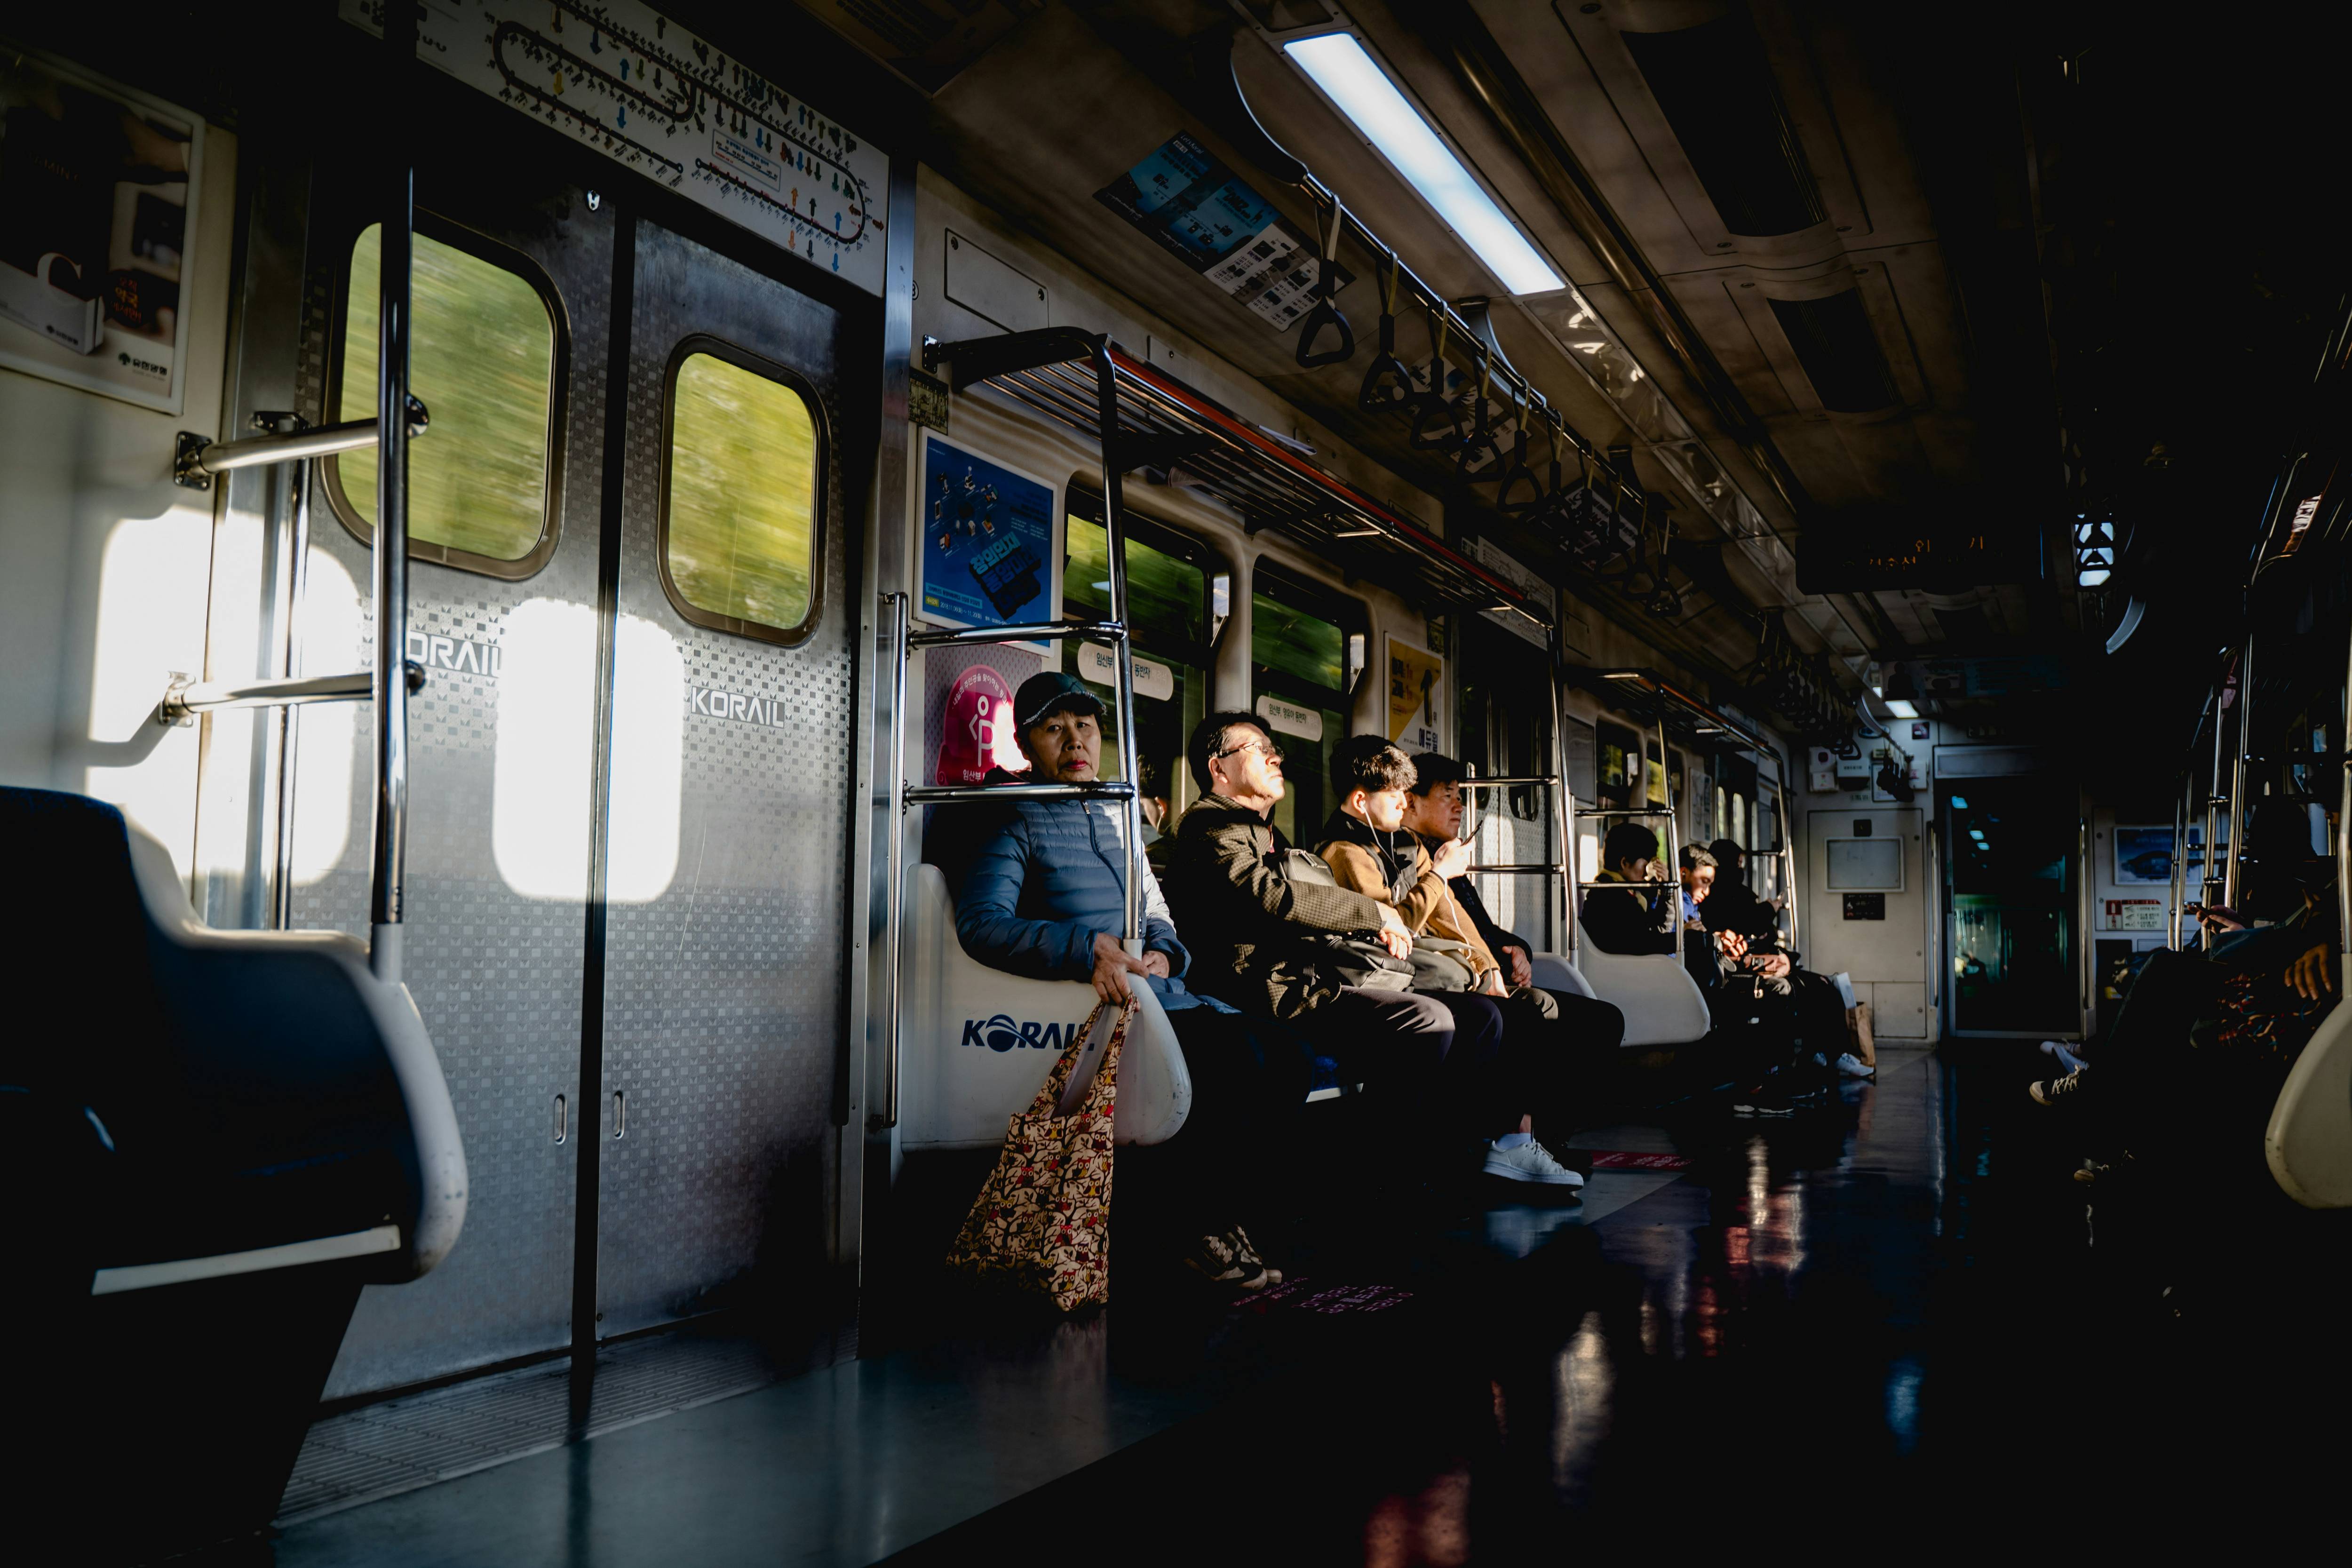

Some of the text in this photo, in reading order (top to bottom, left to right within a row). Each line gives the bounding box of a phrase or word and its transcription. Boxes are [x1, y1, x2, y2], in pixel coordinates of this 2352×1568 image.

[114, 286, 139, 310] 약국
[406, 630, 500, 678] ORAIL
[1135, 663, 1150, 680] 동반자
[964, 673, 982, 689] 주인공을
[982, 673, 1000, 692] 맞이하는
[692, 686, 785, 728] KORAIL
[1283, 707, 1295, 721] 영유아
[1295, 711, 1307, 724] 동반자
[1418, 727, 1438, 754] 에듀윌
[962, 768, 981, 782] 임산부
